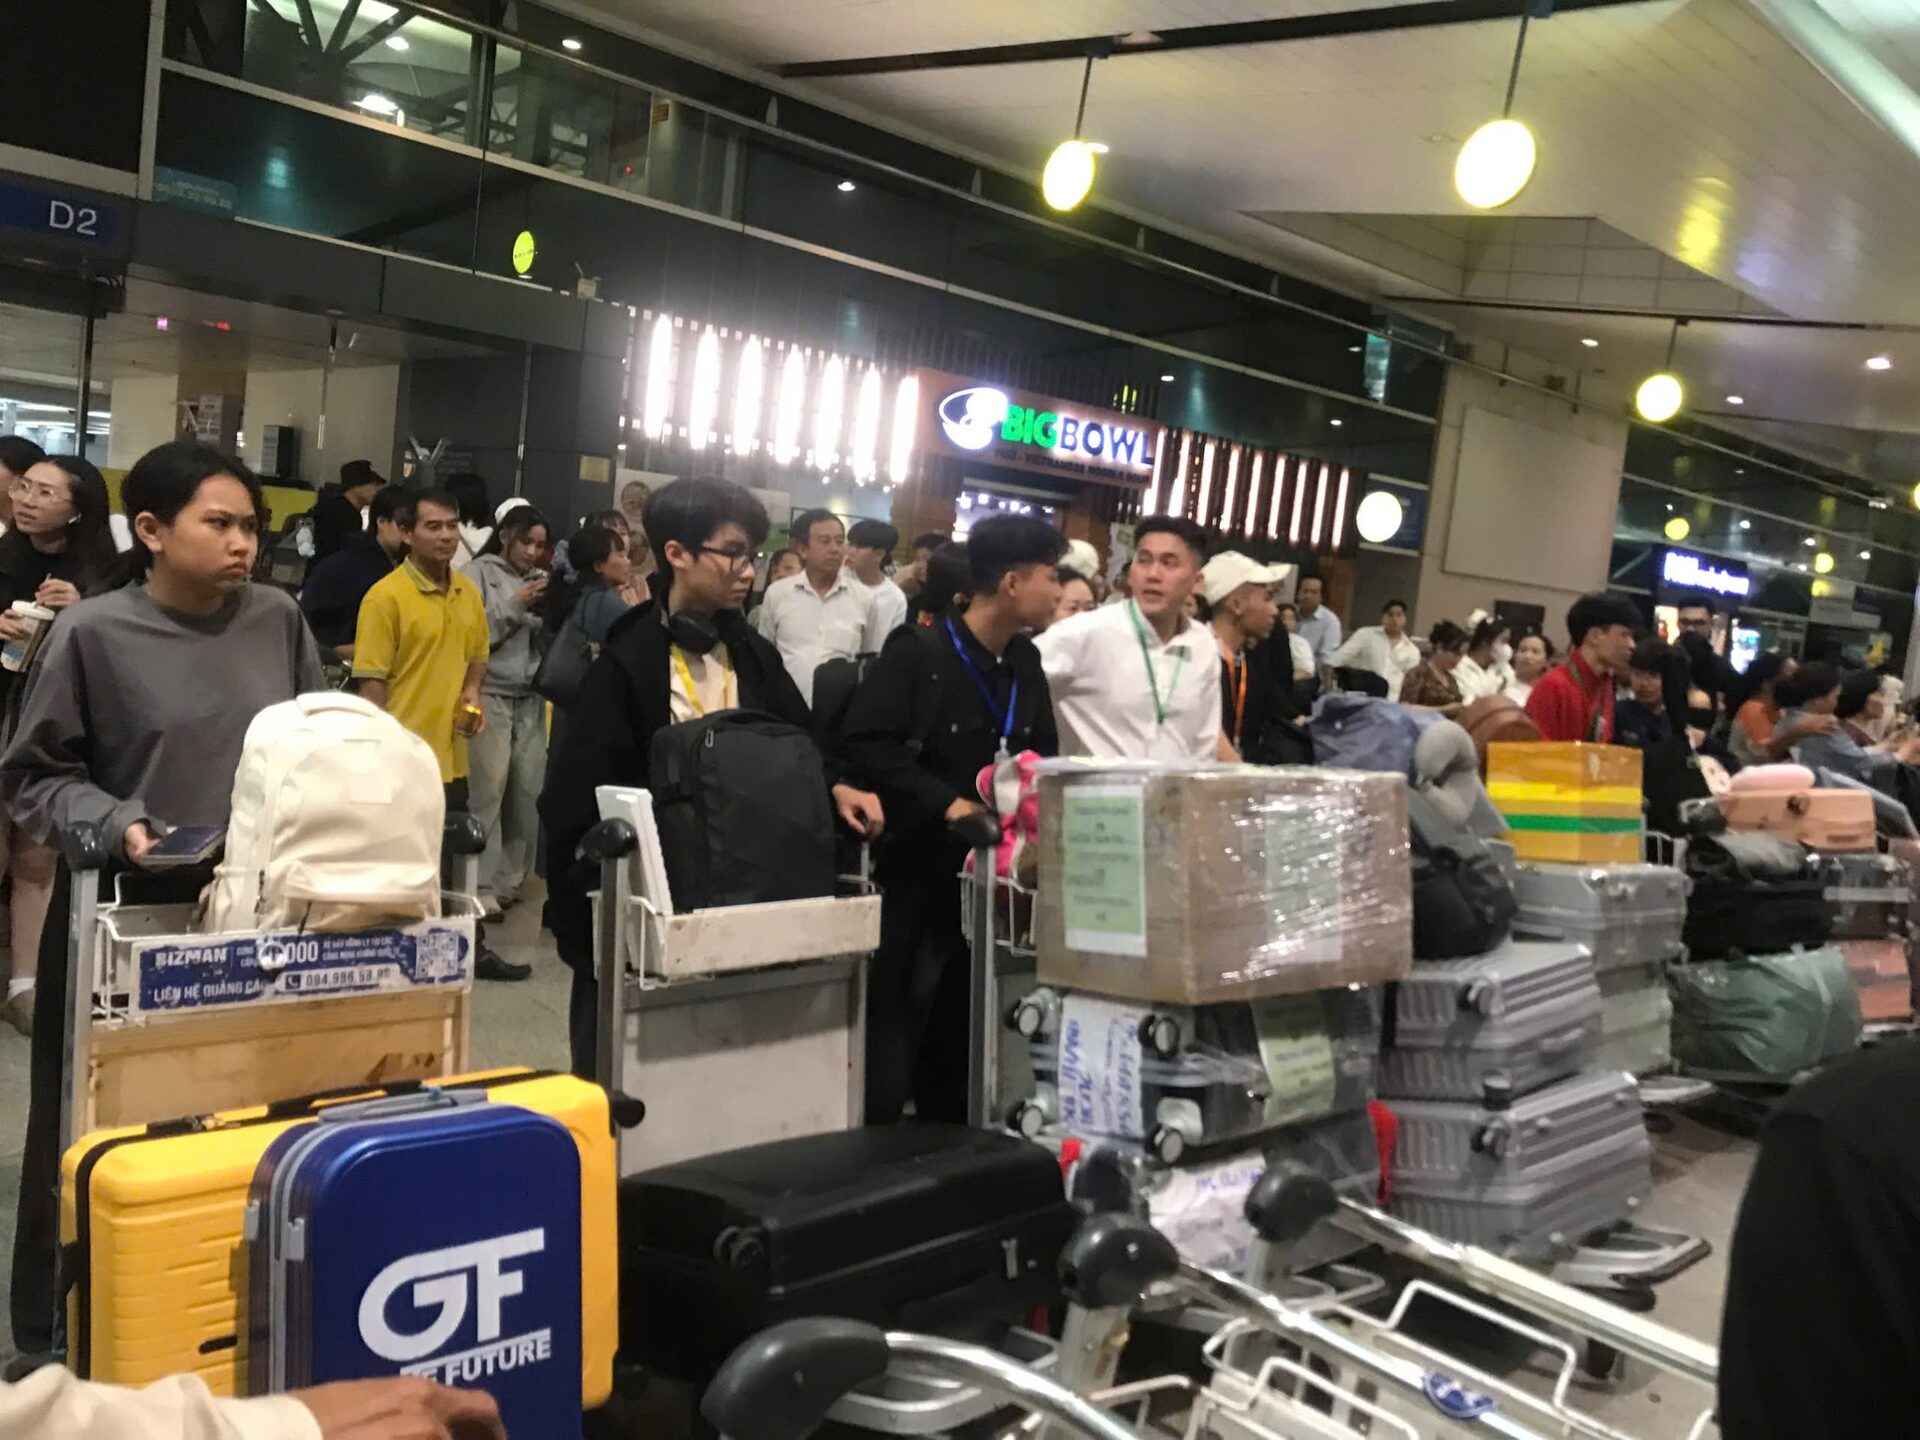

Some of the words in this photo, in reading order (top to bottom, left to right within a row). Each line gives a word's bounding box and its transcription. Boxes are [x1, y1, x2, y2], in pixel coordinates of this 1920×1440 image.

[49, 200, 97, 236] D2
[155, 946, 228, 969] BIZMAN
[358, 1227, 545, 1361] GF
[445, 1336, 551, 1387] FUTURE
